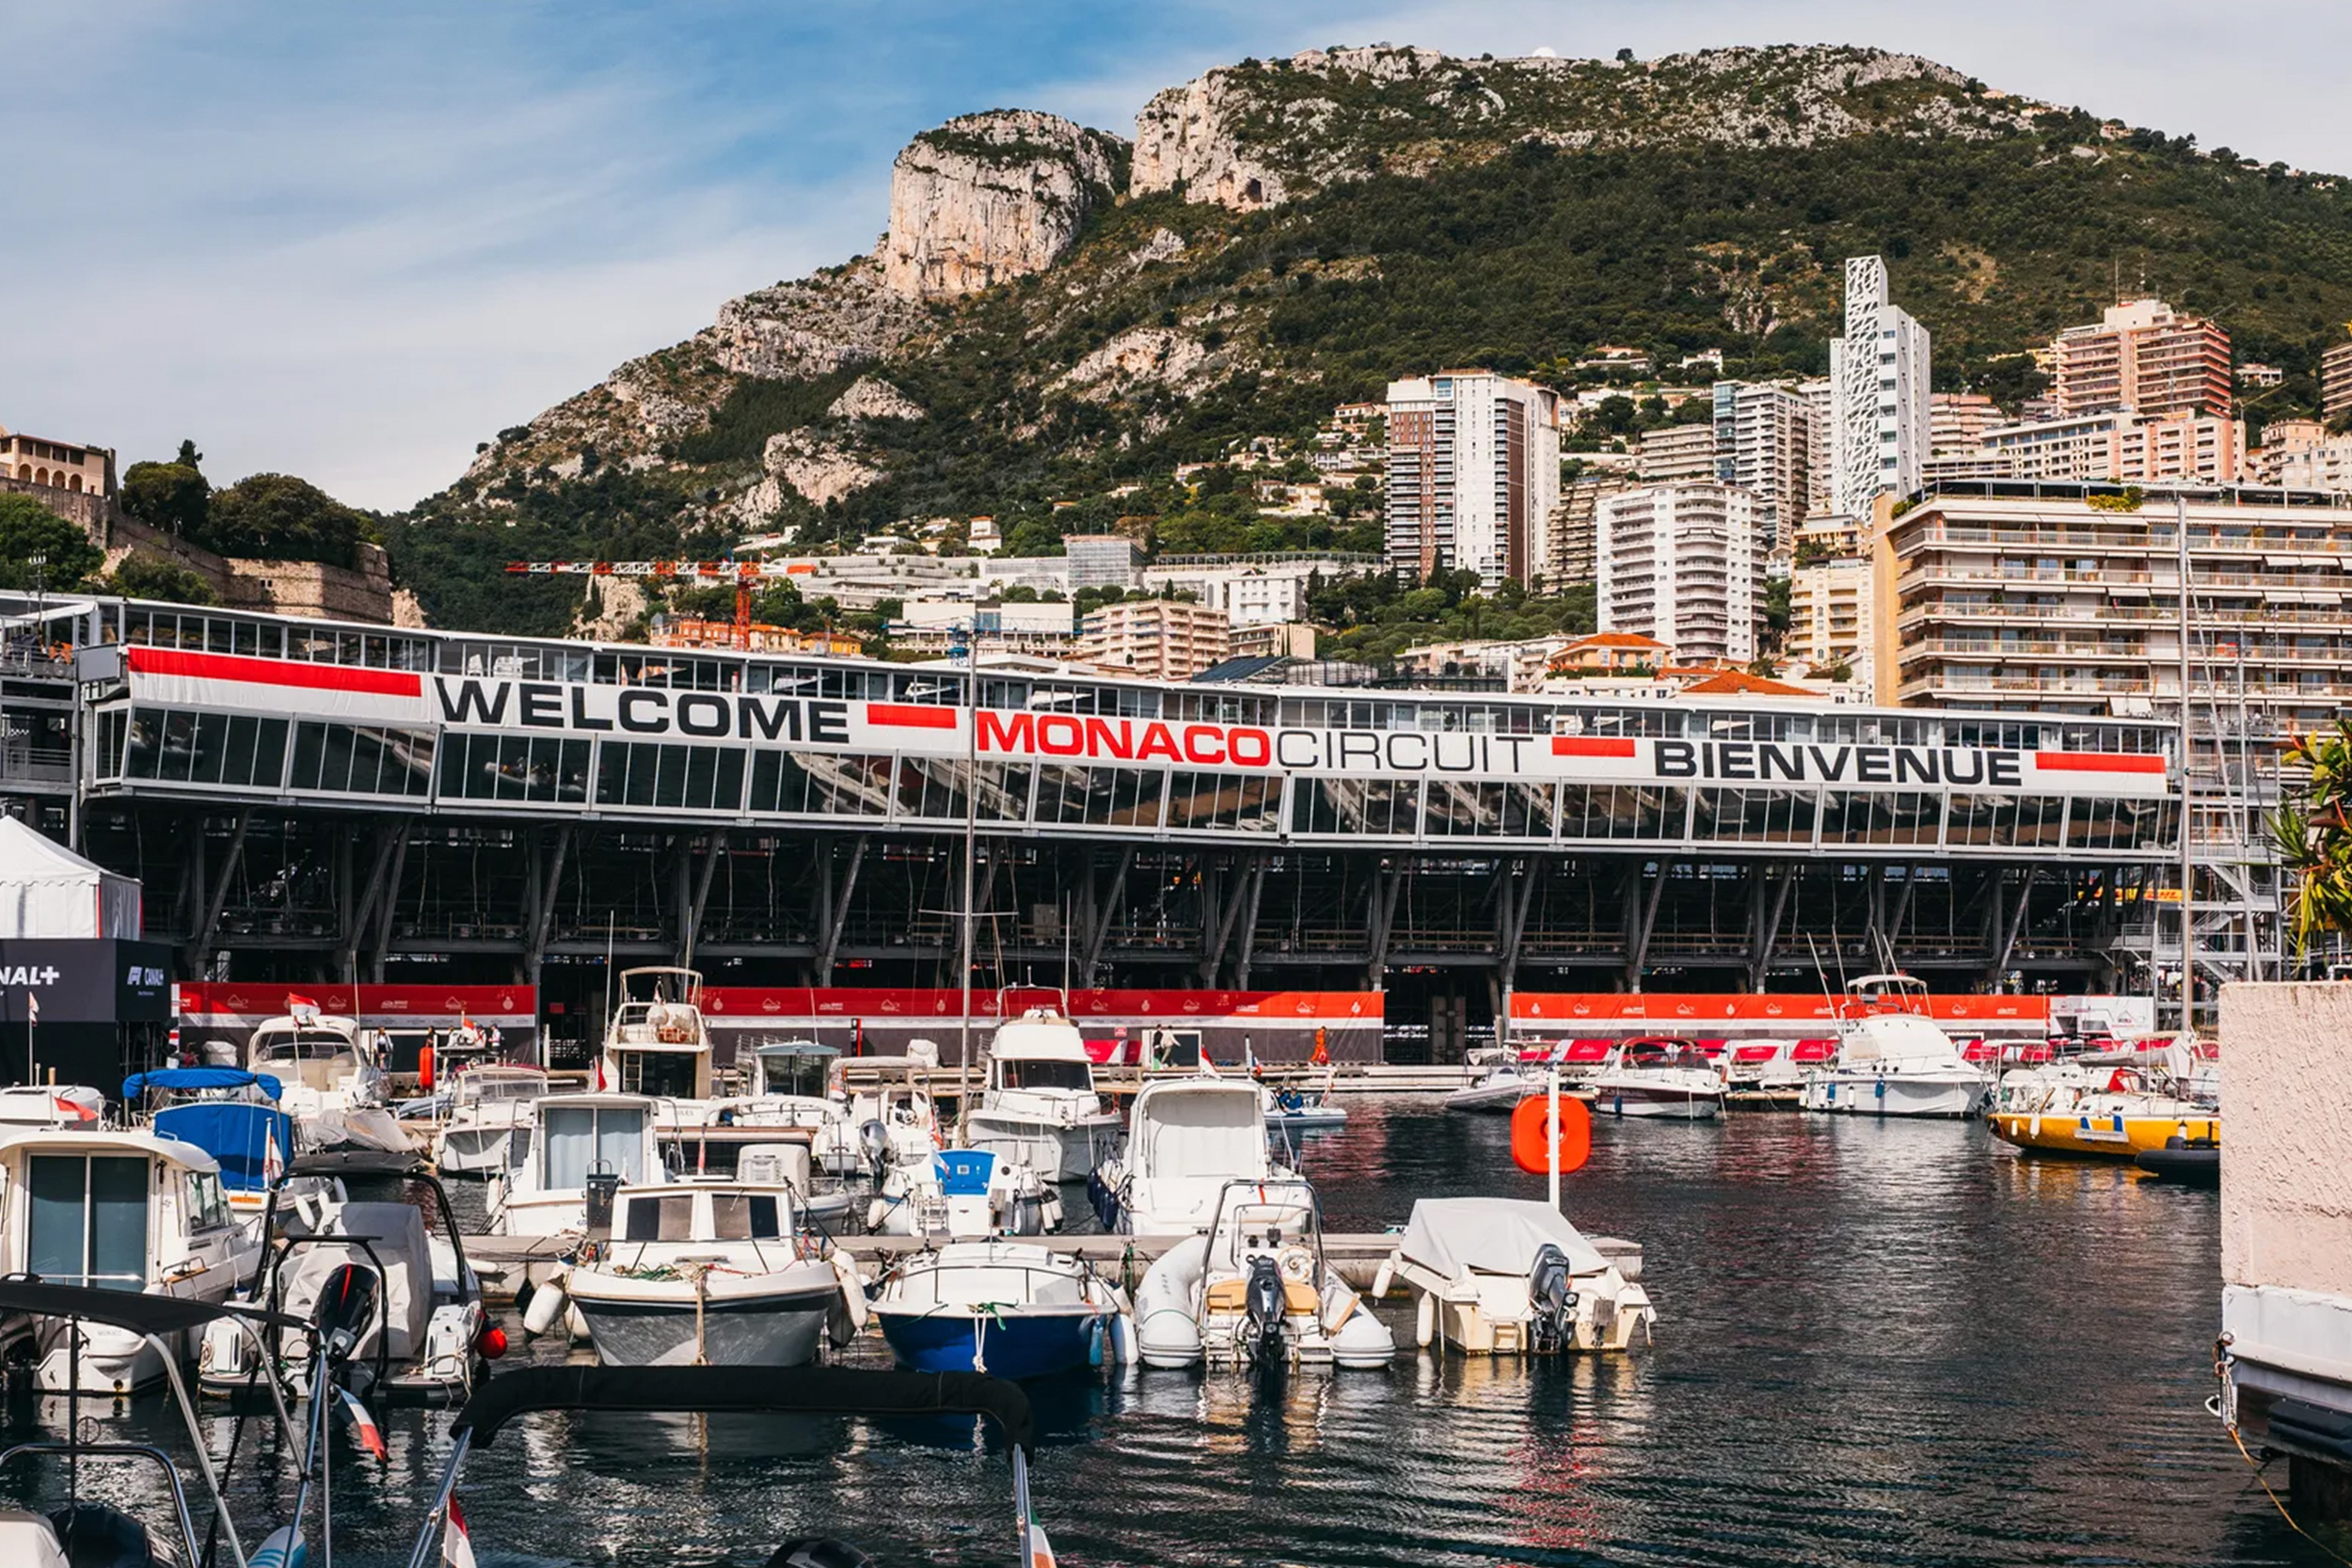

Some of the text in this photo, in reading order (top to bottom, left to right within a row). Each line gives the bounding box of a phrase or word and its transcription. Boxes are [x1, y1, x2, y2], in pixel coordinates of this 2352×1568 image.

[435, 675, 850, 744] WELCOME
[976, 711, 1534, 773] MONACO CIRCUIT
[1654, 739, 2023, 787] BIENVENUE
